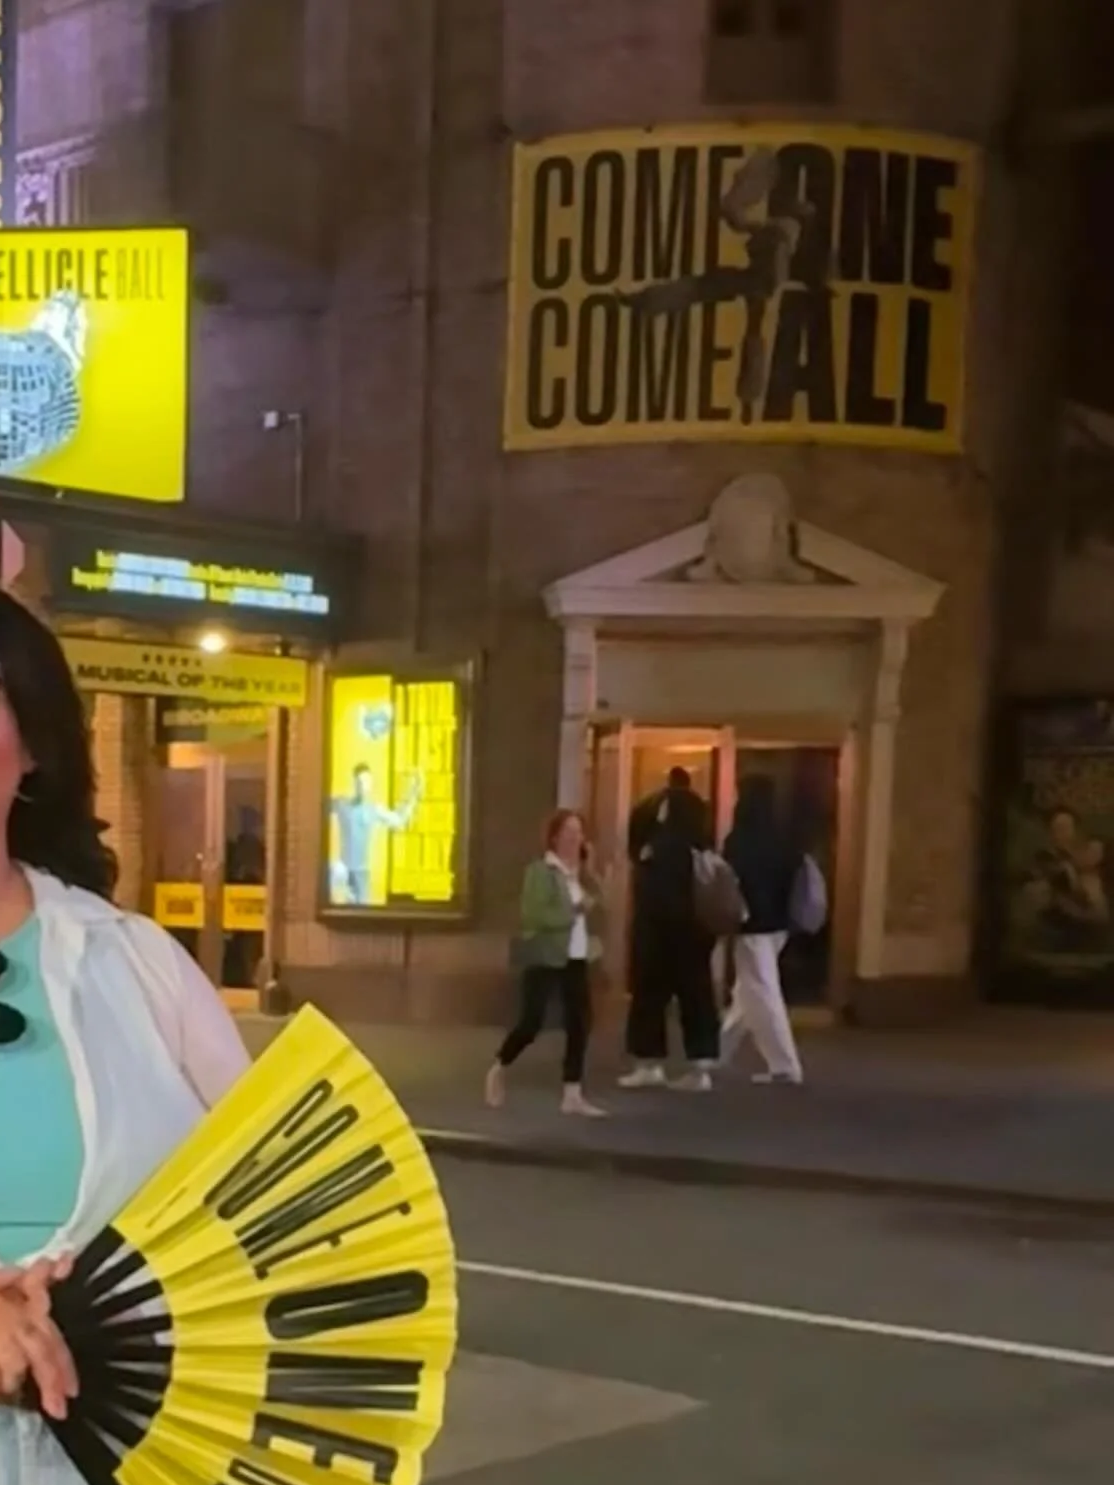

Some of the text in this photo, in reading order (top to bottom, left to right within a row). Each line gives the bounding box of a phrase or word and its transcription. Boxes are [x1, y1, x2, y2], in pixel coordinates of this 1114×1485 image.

[532, 143, 958, 292] COME ONE
[115, 247, 167, 301] BALL
[526, 287, 948, 431] COME ALL
[77, 664, 303, 695] MUSICAL OF THE YEAR
